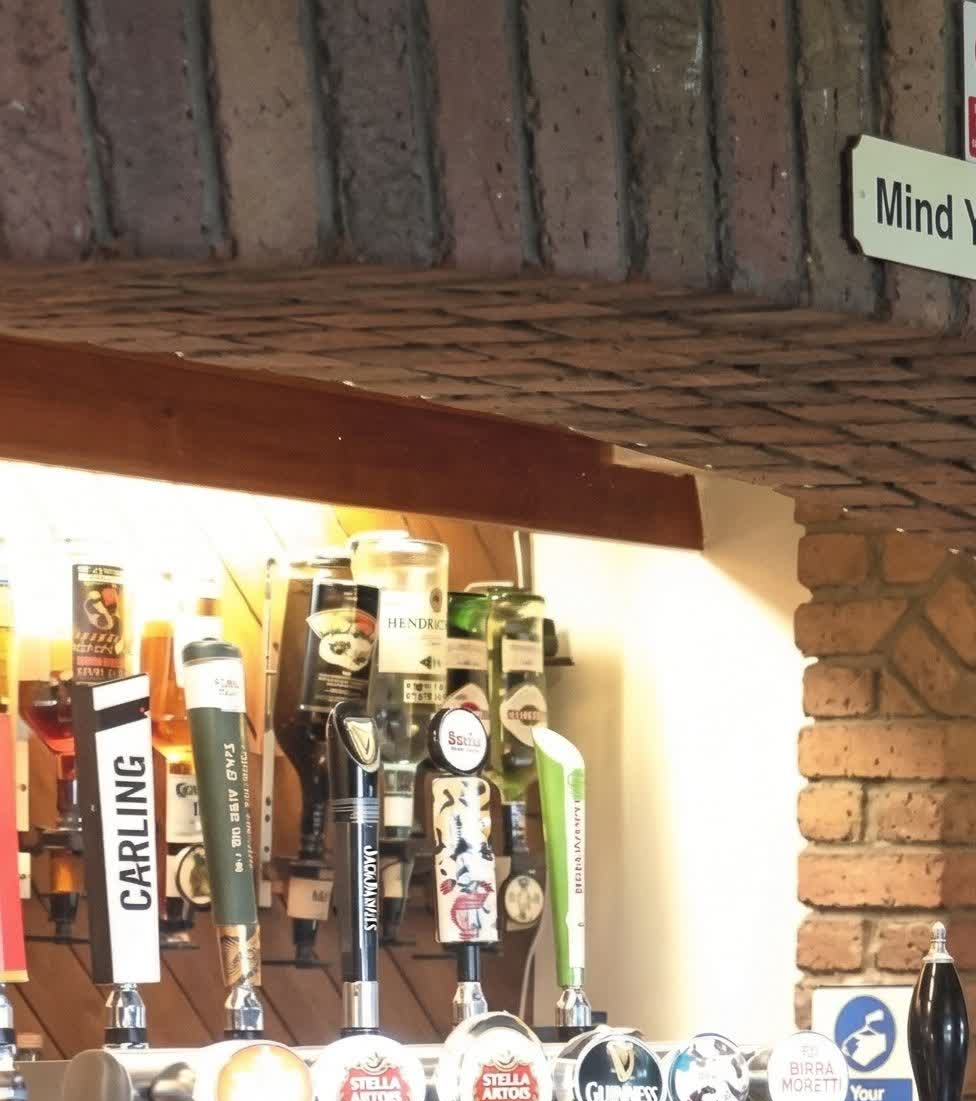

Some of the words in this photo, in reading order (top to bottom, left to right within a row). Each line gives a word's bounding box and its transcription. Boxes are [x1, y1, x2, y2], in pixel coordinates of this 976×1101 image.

[876, 177, 953, 240] Mind
[113, 755, 152, 911] CARLING
[790, 1061, 834, 1076] BIRRA
[349, 1076, 401, 1091] STELLA
[483, 1072, 530, 1087] STELLA
[781, 1078, 842, 1093] MORETTI
[849, 1084, 885, 1101] Your
